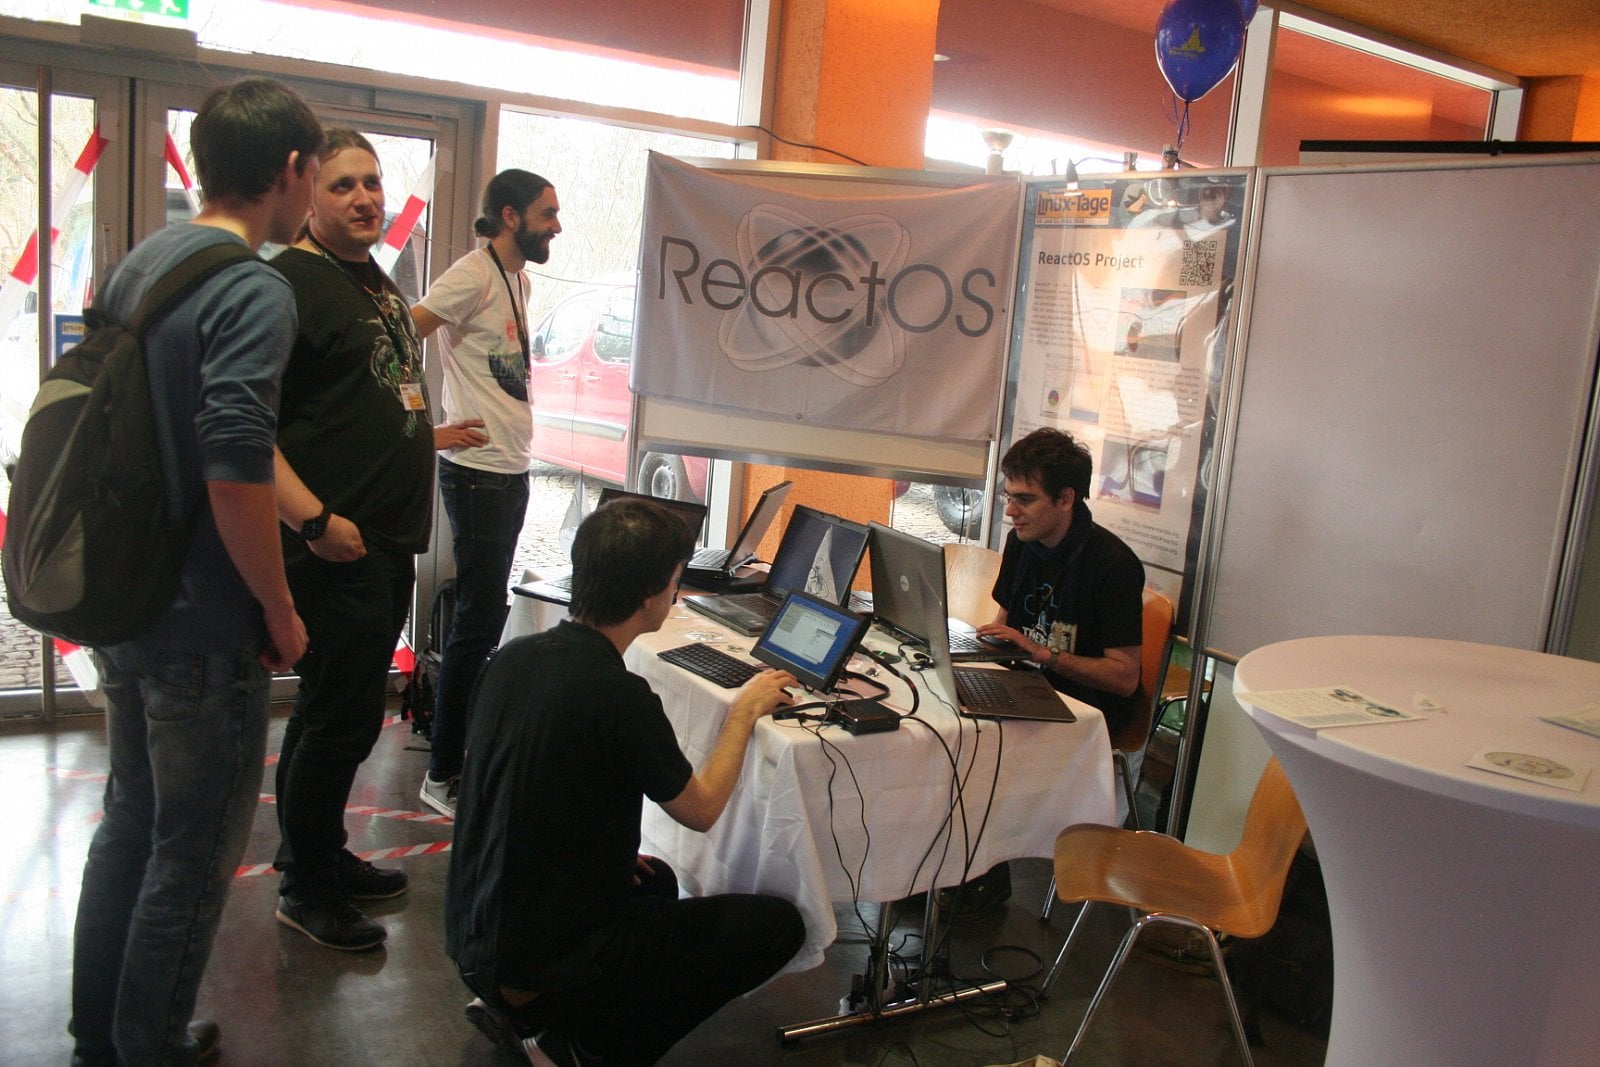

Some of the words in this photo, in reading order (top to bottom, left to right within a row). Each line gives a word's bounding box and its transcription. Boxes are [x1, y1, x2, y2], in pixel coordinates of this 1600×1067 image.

[658, 235, 997, 338] ReactOS
[1038, 250, 1092, 267] ReactOS
[1095, 252, 1145, 271] Project
